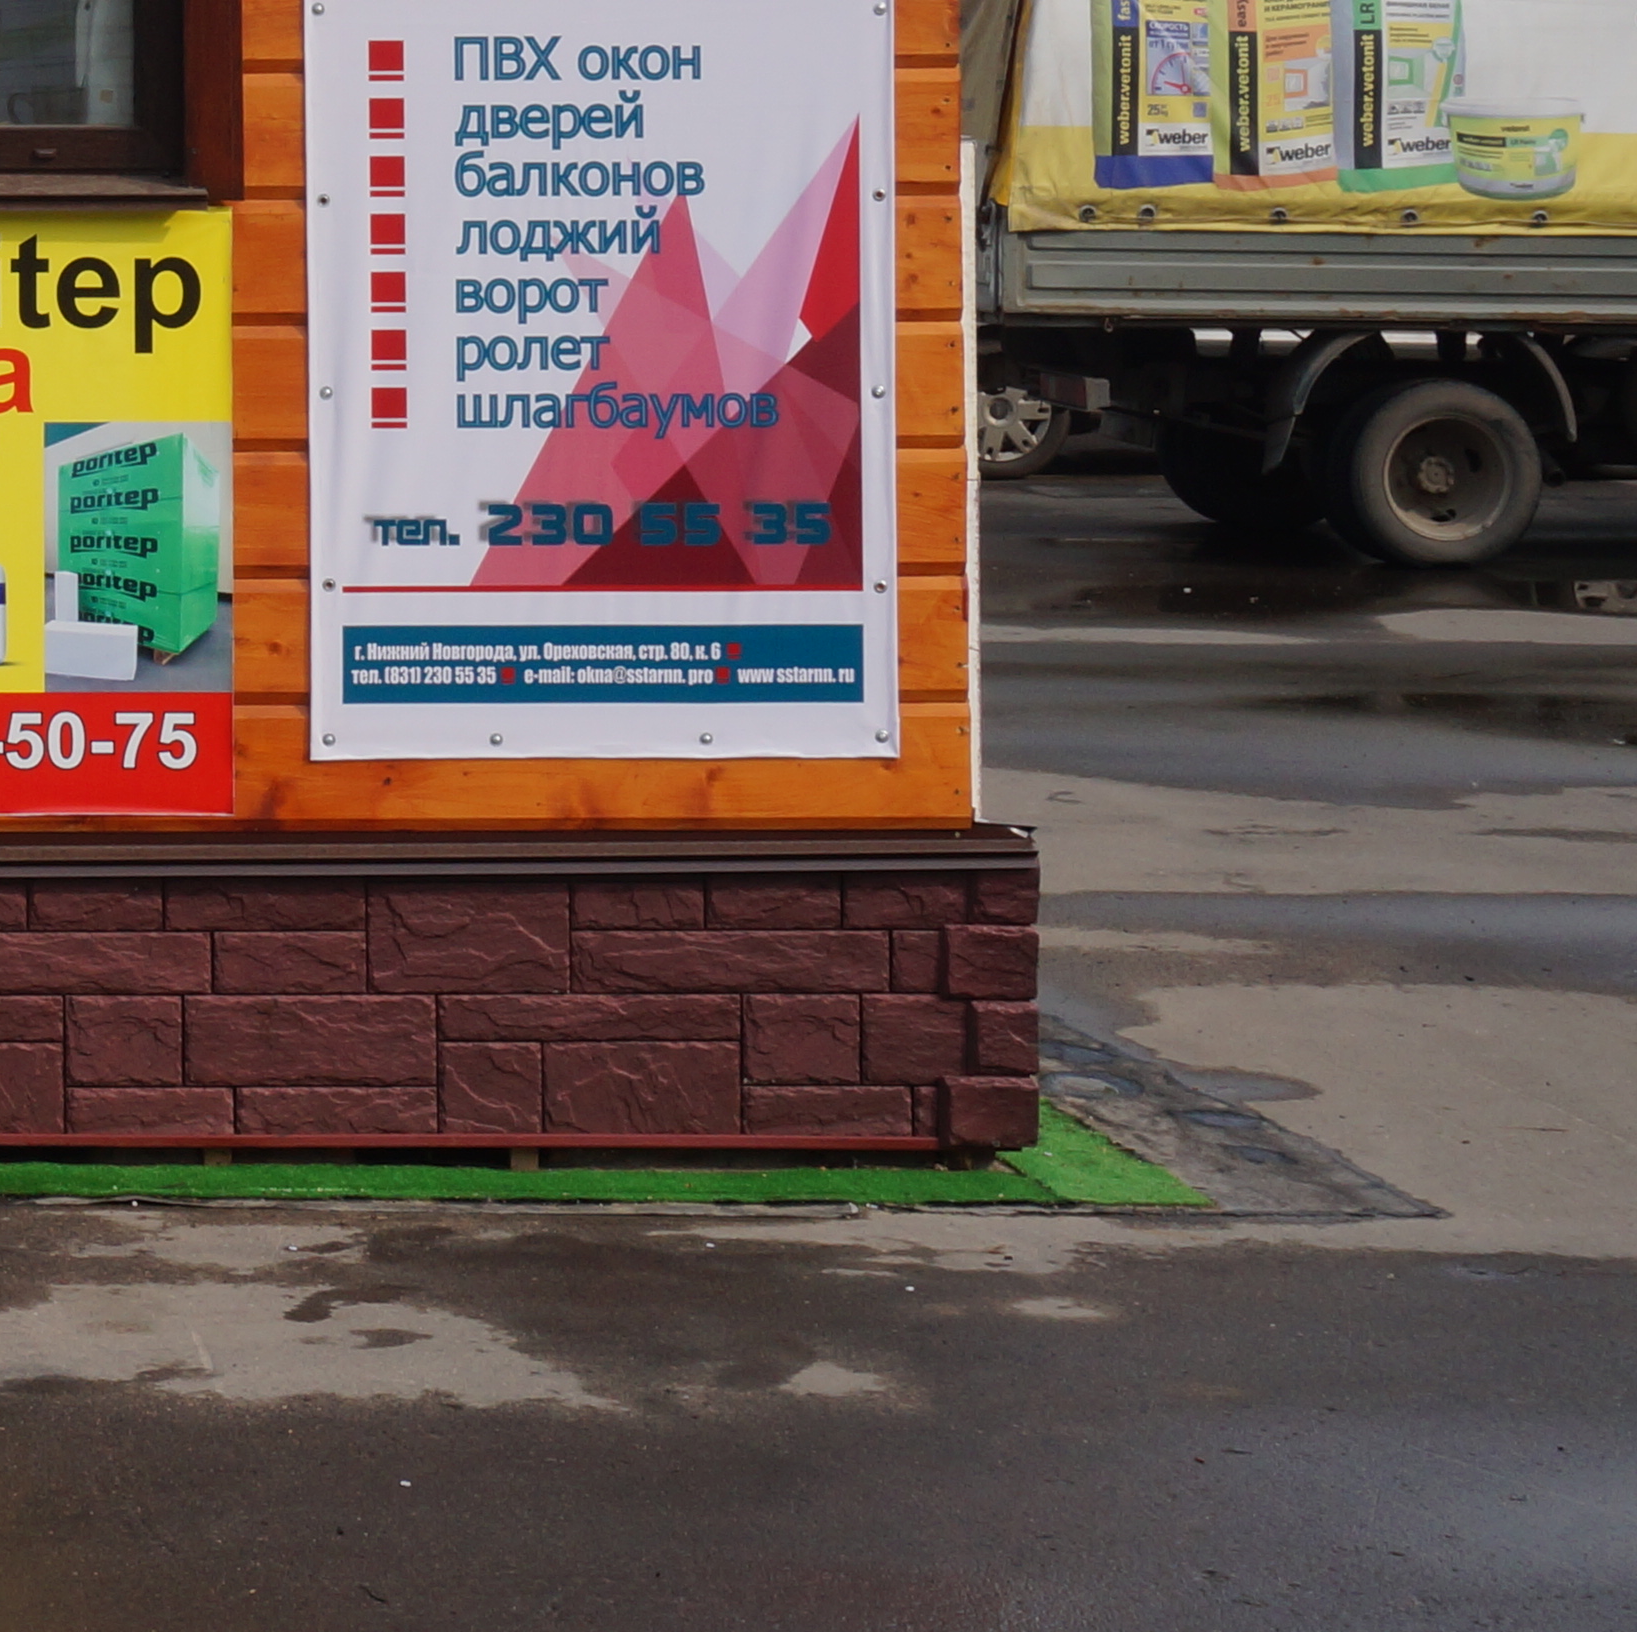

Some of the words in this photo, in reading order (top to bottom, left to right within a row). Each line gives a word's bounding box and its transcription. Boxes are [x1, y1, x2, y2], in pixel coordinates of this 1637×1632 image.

[1360, 2, 1375, 25] LR
[453, 36, 562, 80] ПВХ
[577, 45, 701, 80] окон
[1117, 35, 1132, 145] weber.vetonit
[1147, 104, 1160, 115] 25
[1234, 35, 1250, 152] weber.vetonit
[1360, 34, 1375, 147] weber.vetonit
[455, 91, 645, 148] дверей
[1158, 129, 1208, 145] weber
[1280, 143, 1331, 161] weber
[1400, 137, 1450, 153] weber
[453, 151, 705, 196] балконов
[455, 206, 662, 260] лоджий
[455, 278, 609, 323] ворот
[455, 335, 610, 381] ролет
[455, 382, 780, 439] шлагбаумов
[72, 442, 157, 478] poritep
[70, 488, 159, 514] poritep
[373, 517, 461, 547] тел.
[486, 504, 614, 546] 230
[640, 502, 722, 545] 55
[752, 502, 832, 545] 35
[70, 534, 158, 558] poritep
[354, 645, 365, 661] г.
[367, 642, 429, 661] Нижний
[432, 642, 517, 663] Новгорода,
[519, 645, 541, 662] ул.
[543, 642, 637, 661] Ореховская,
[638, 644, 668, 662] стр.
[670, 642, 693, 662] 80,
[695, 645, 709, 660] к.
[711, 642, 721, 660] 6
[351, 669, 382, 684] тел.
[384, 666, 421, 684] (831)
[424, 666, 452, 684] 230
[455, 666, 474, 684] 55
[477, 666, 496, 684] 35
[524, 666, 575, 684] e-mail:
